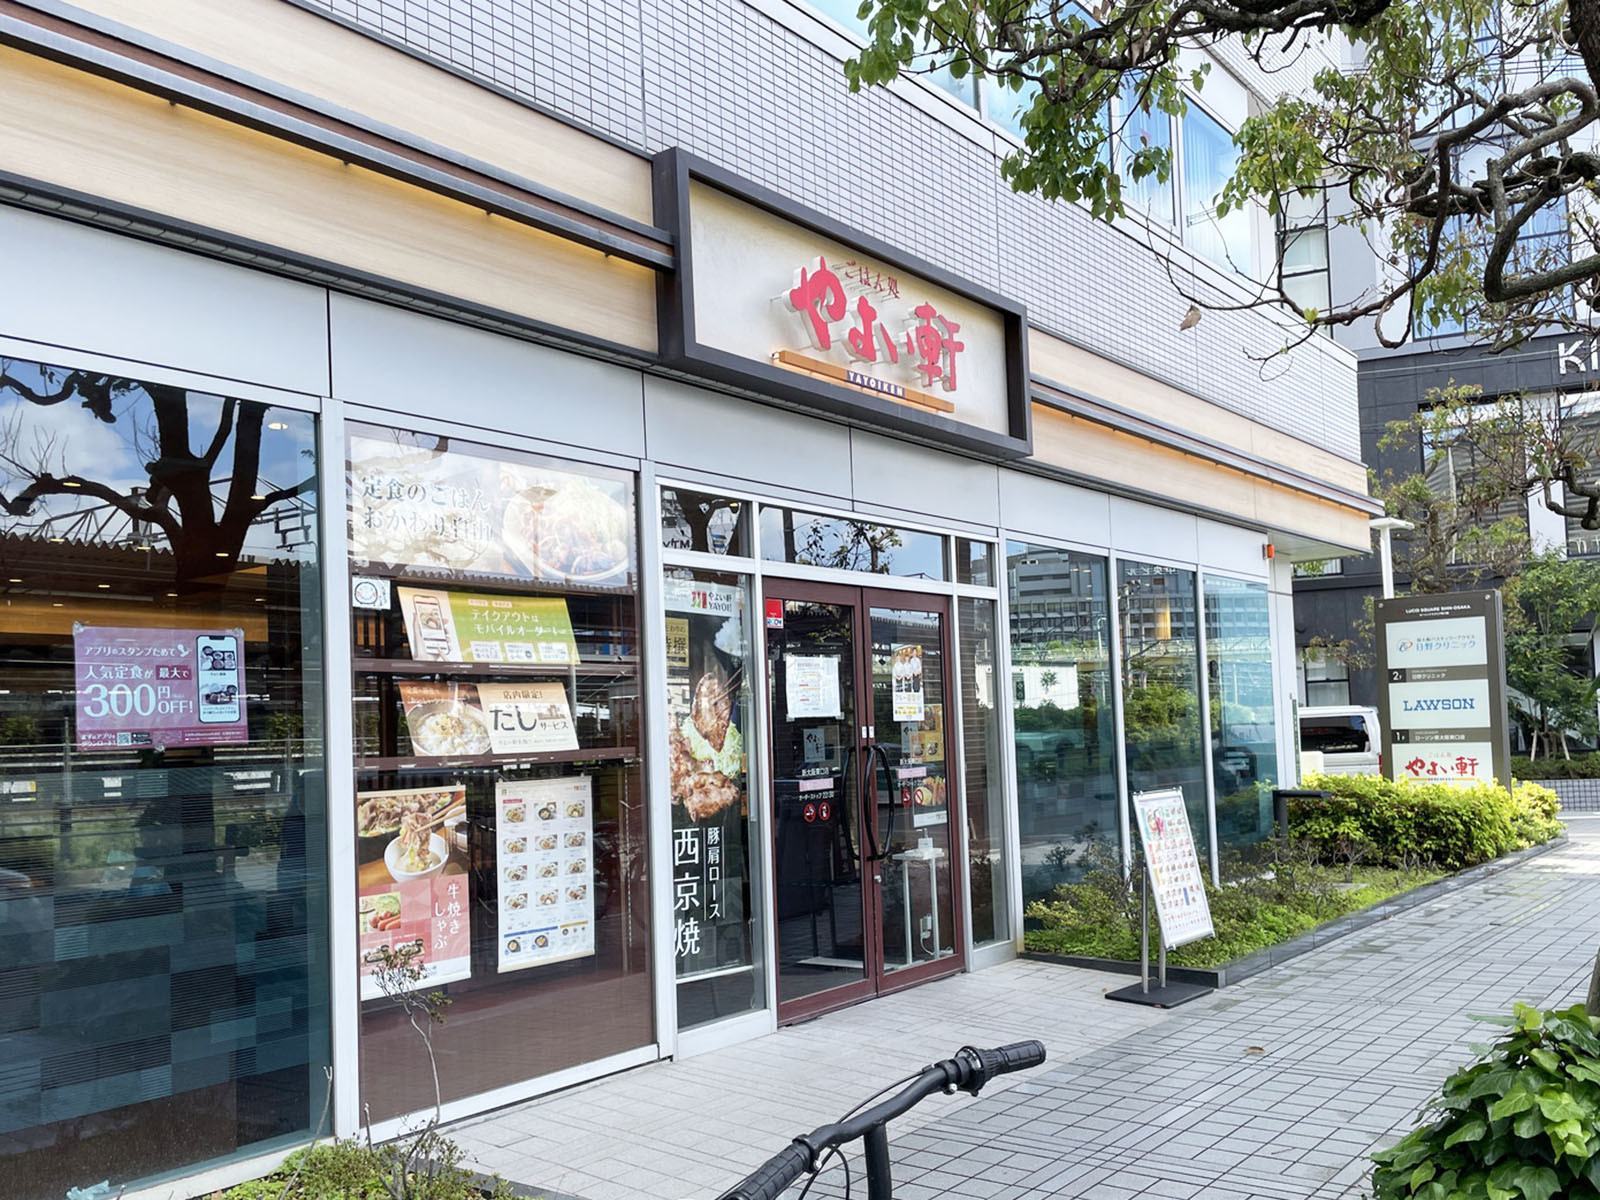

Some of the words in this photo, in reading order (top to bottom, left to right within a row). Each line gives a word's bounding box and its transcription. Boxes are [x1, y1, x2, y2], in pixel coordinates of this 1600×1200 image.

[789, 255, 965, 392] やよい軒
[848, 371, 904, 397] YAYOIKEN
[84, 665, 154, 680] 人気定食が
[159, 667, 189, 679] 最大で
[83, 683, 157, 718] 300
[157, 686, 171, 699] 円
[157, 701, 193, 714] OFF!
[1403, 698, 1475, 712] LAWSON
[1405, 756, 1479, 777] やよい軒
[707, 826, 721, 919] 豚肩ロース
[673, 827, 700, 957] 西京焼
[447, 882, 462, 935] 牛焼き
[434, 902, 448, 950] しゃぶ
